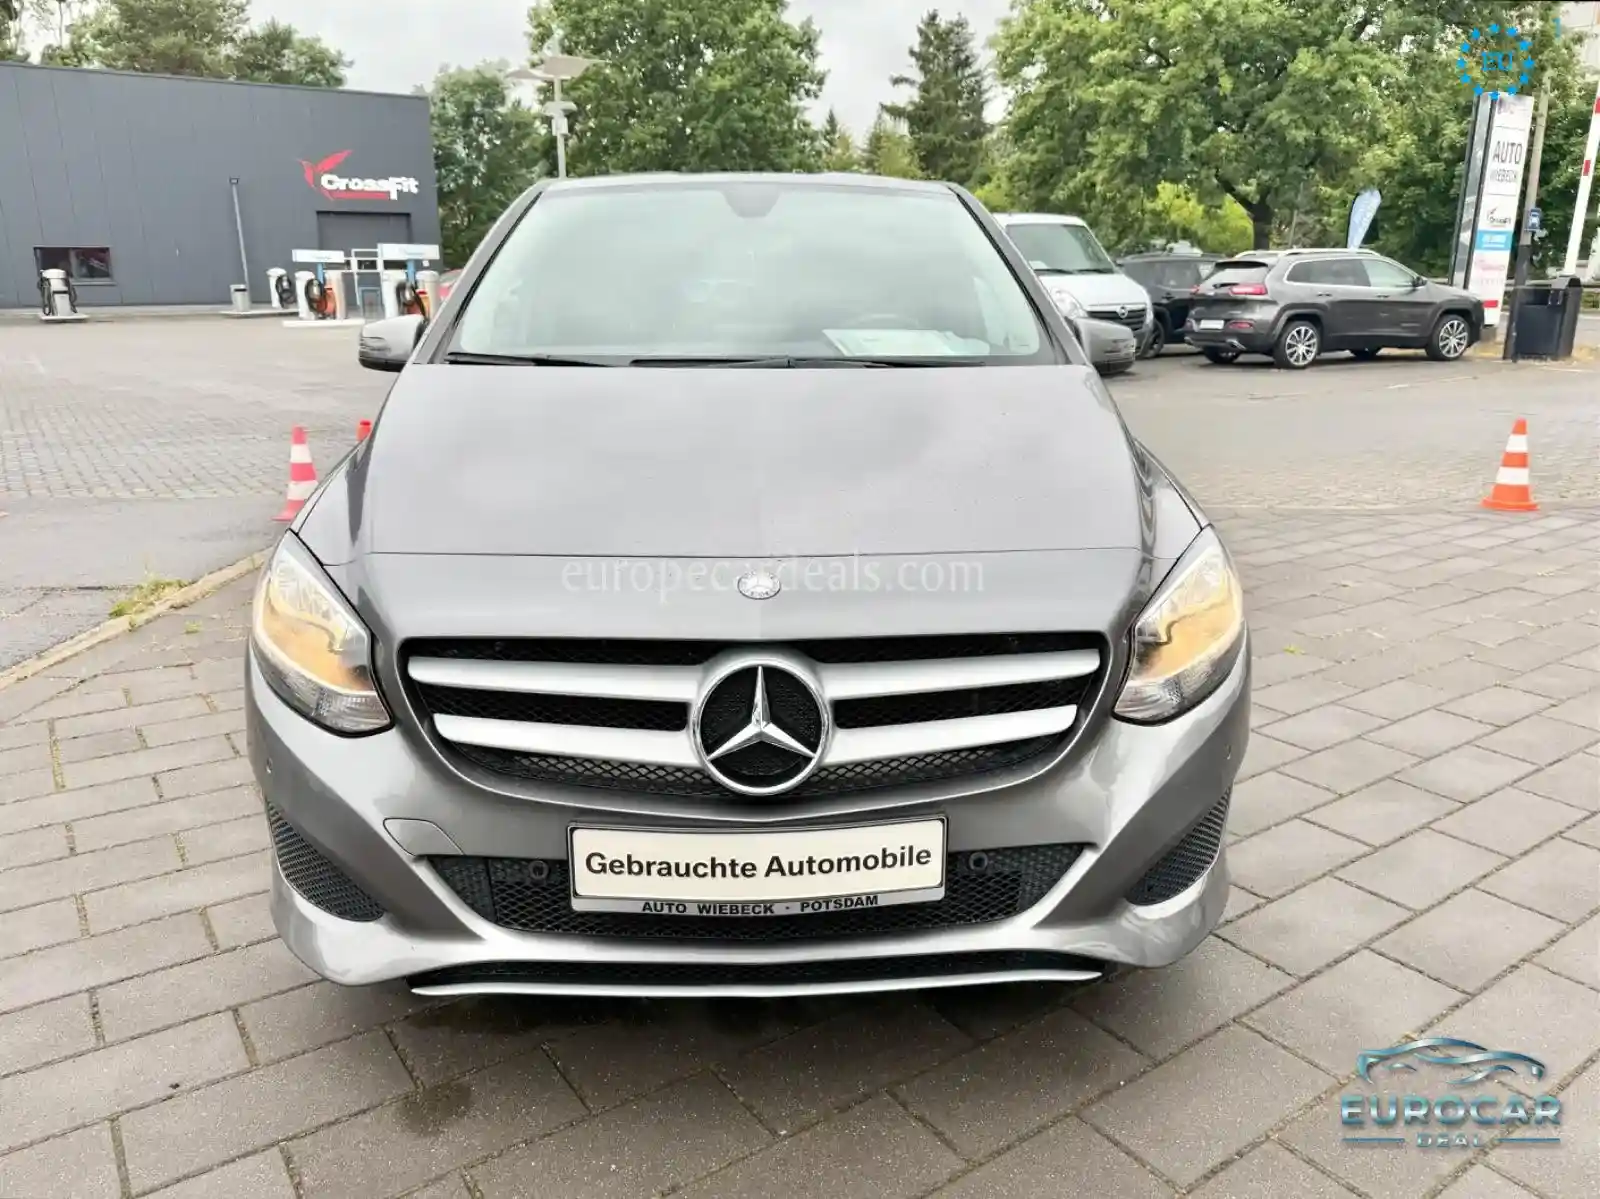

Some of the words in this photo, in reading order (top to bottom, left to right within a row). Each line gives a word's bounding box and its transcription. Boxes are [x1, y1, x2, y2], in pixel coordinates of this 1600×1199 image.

[1493, 140, 1522, 165] AUTO
[585, 851, 757, 878] Gebrauchte
[764, 845, 932, 877] Automobile
[642, 901, 687, 914] AUTO
[697, 902, 775, 915] WIEBECK
[800, 895, 879, 913] POTSDAM
